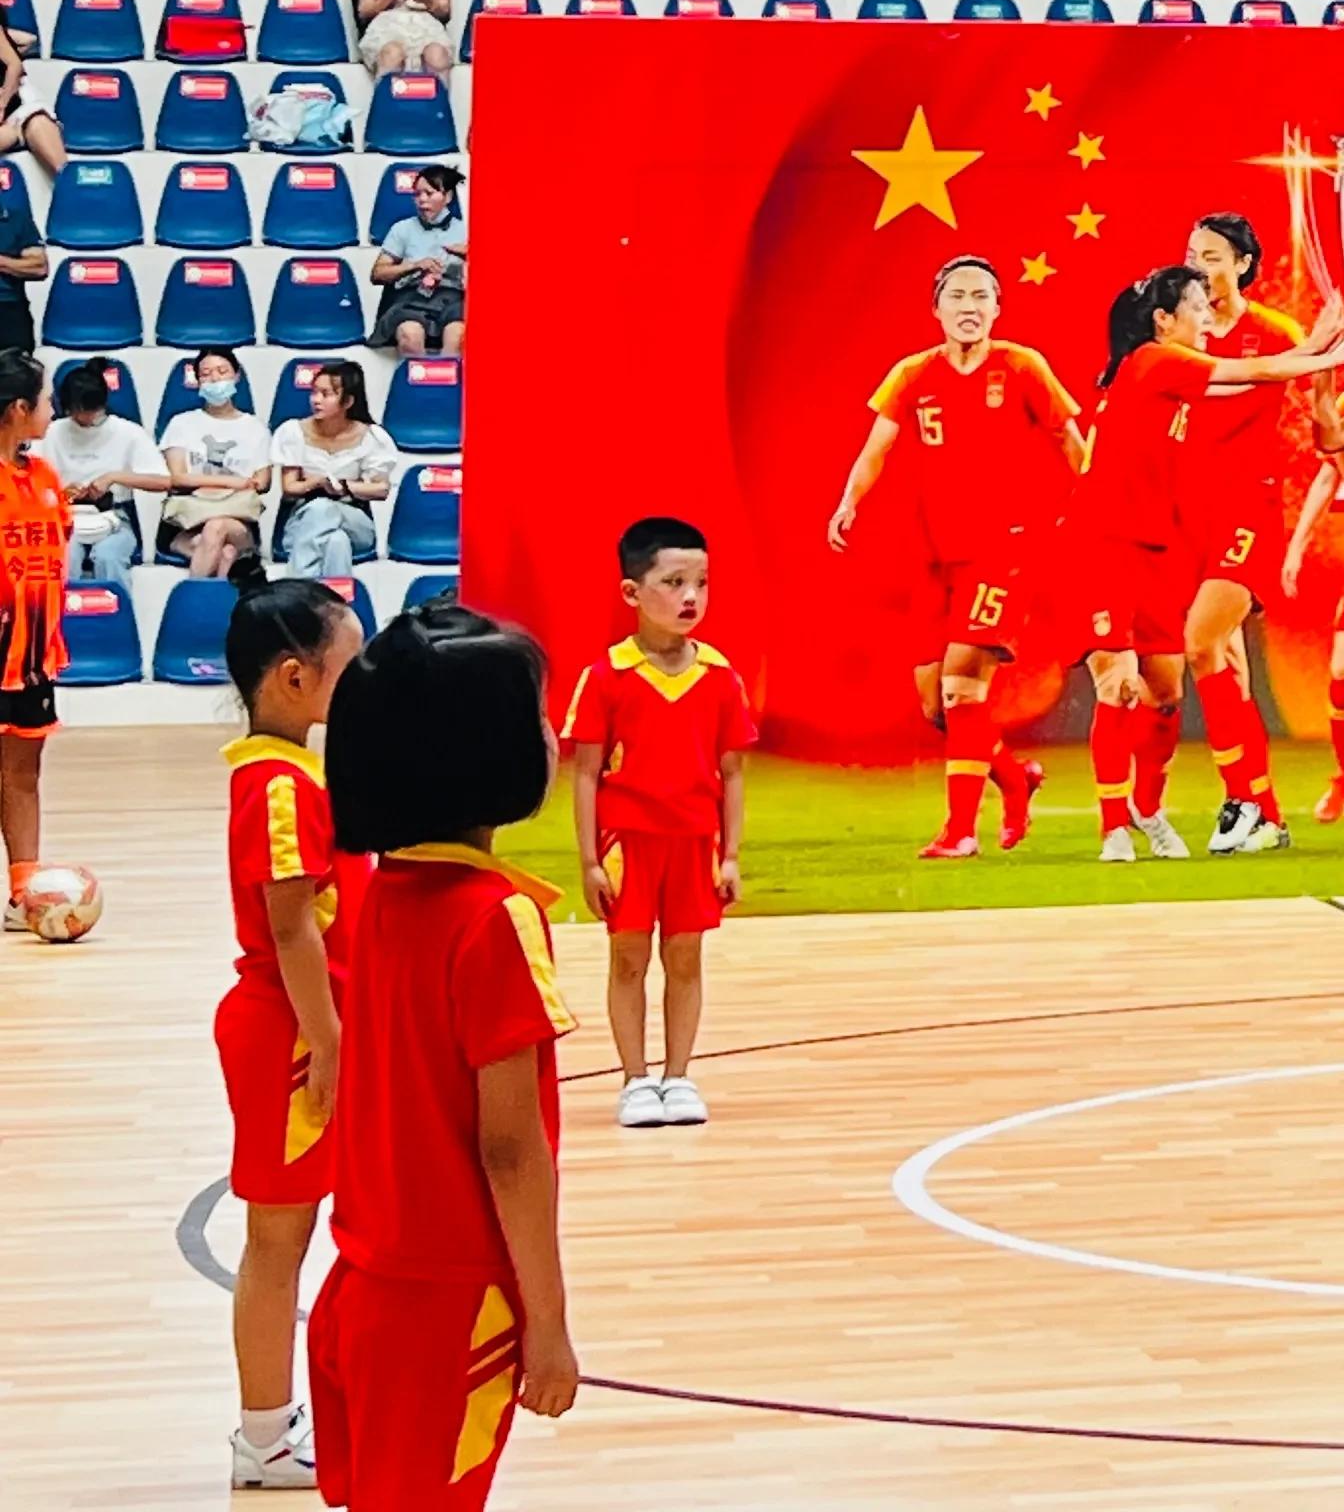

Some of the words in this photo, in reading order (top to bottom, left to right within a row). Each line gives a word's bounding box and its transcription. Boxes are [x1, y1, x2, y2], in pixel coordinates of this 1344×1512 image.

[916, 407, 944, 445] 15
[1225, 527, 1256, 564] 3
[969, 583, 1008, 626] 15
